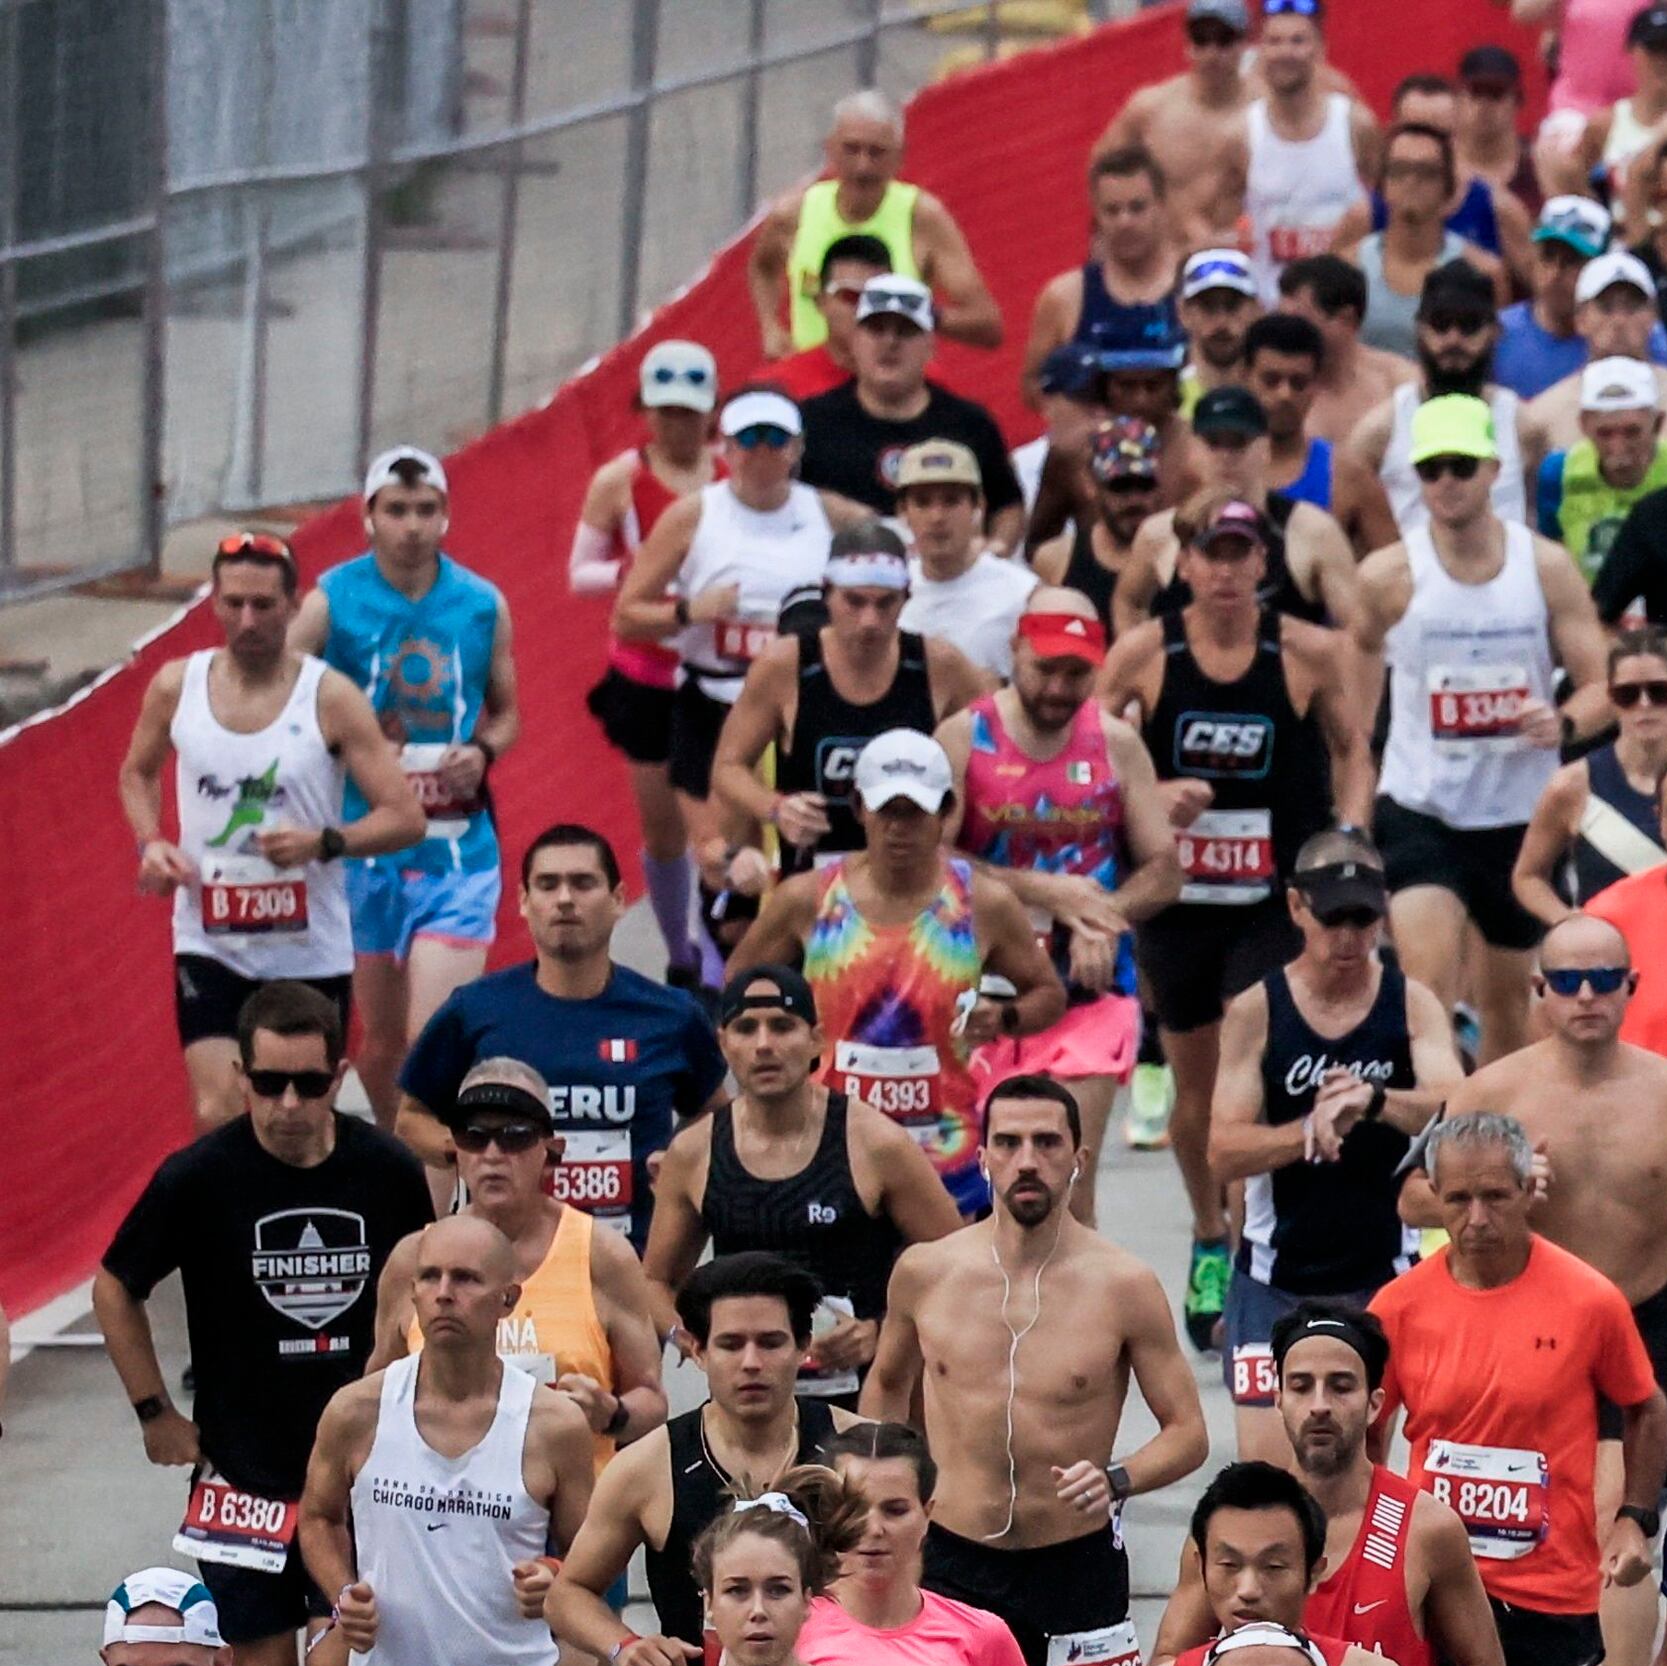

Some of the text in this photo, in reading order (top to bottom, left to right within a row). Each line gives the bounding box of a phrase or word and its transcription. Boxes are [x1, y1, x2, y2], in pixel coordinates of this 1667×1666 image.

[1201, 841, 1260, 870] 4314
[212, 889, 295, 919] B 7309
[552, 1086, 635, 1118] ERU
[868, 1077, 930, 1110] 4393
[553, 1166, 620, 1199] 5386
[252, 1254, 370, 1278] FINISHER
[1234, 1361, 1248, 1394] B
[201, 1486, 285, 1532] B 6380
[374, 1489, 511, 1520] CHICAGO MARATHON
[1434, 1478, 1529, 1521] B 8204
